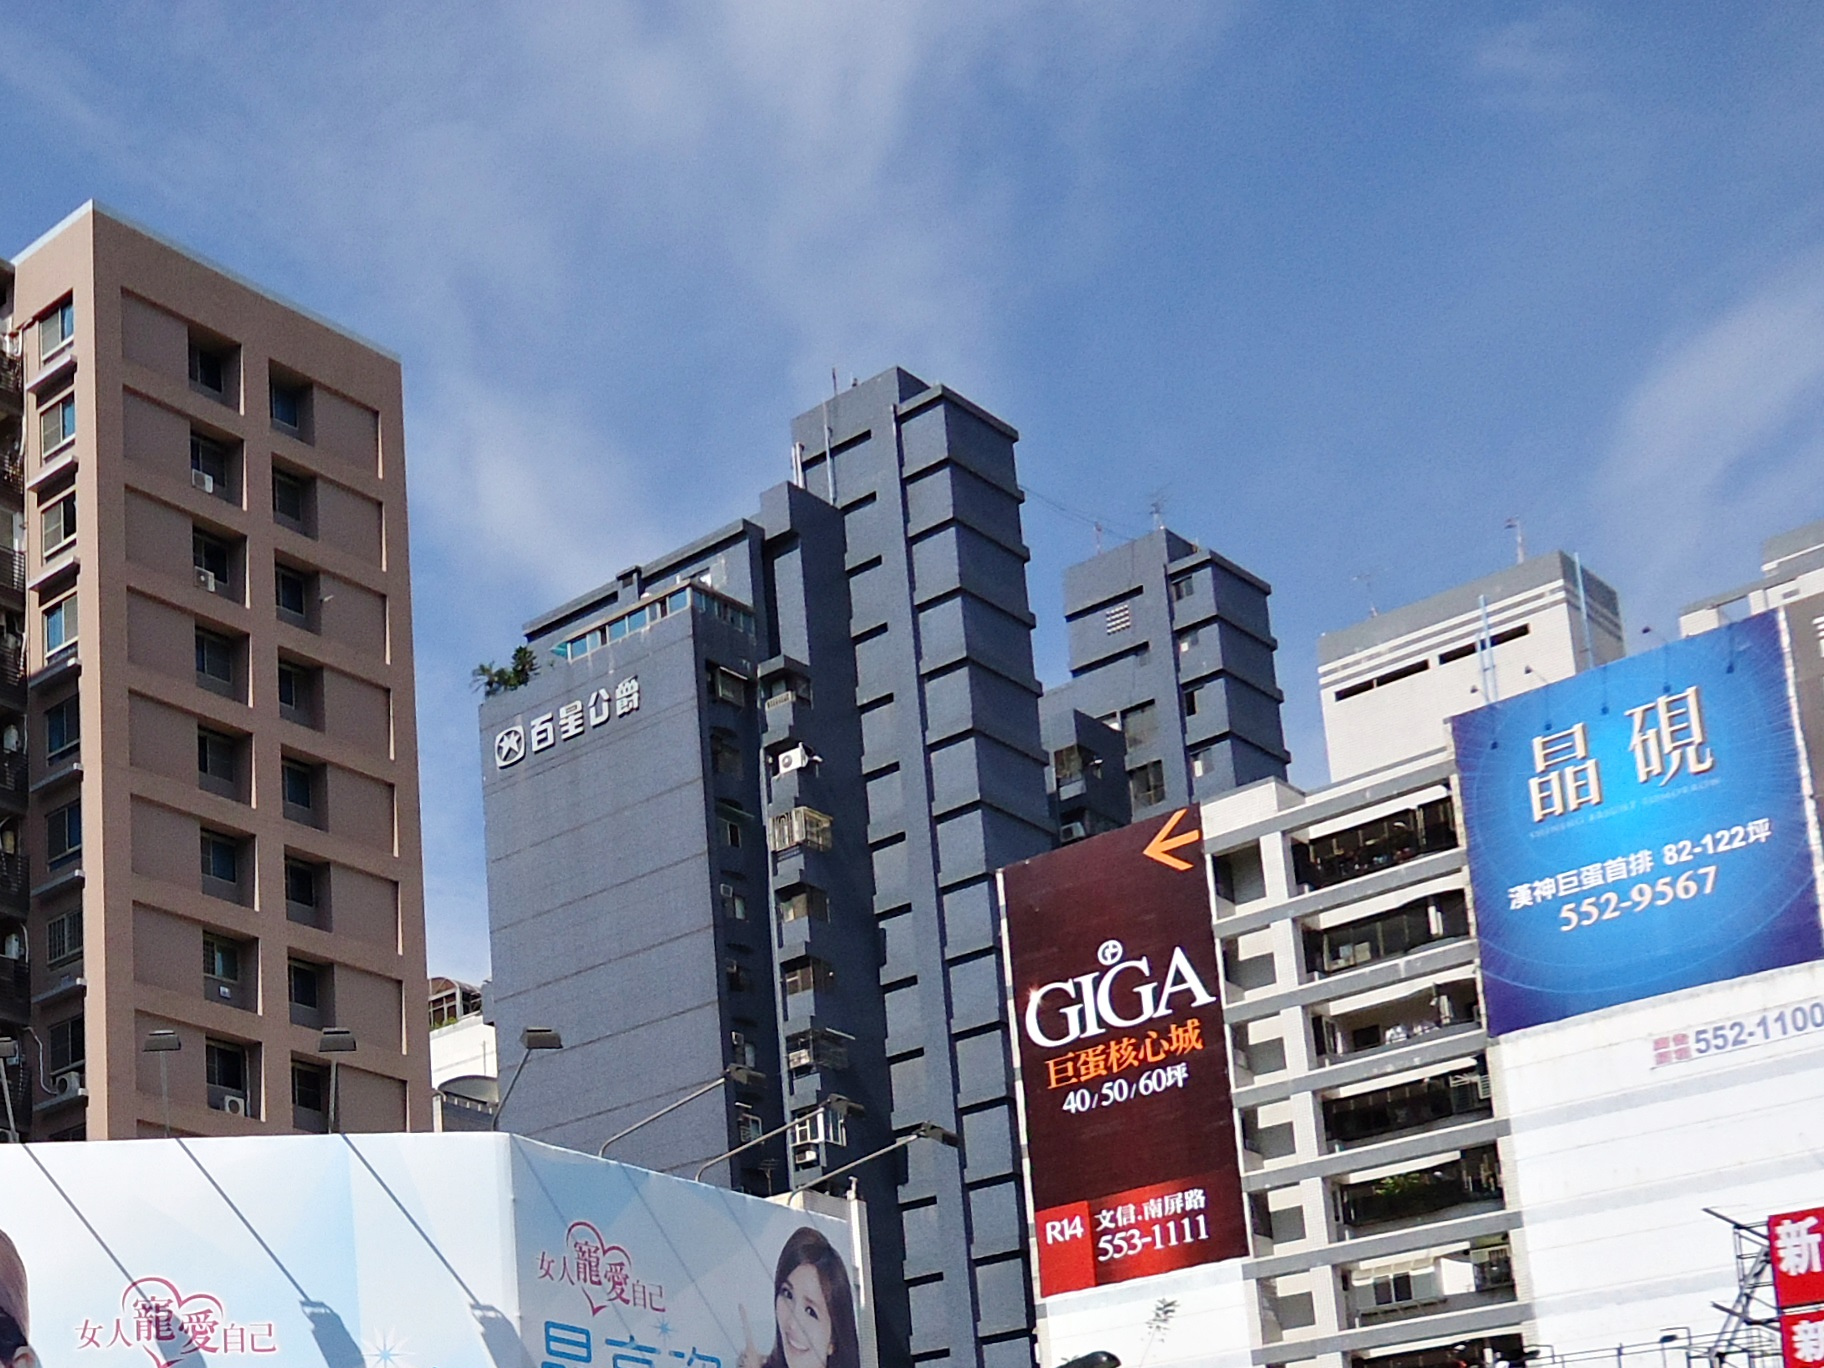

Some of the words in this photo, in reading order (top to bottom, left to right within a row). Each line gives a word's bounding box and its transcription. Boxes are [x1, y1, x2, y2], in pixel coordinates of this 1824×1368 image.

[1528, 686, 1714, 823] 晶硯
[1507, 850, 1653, 911] 漢神巨蛋首排
[1662, 817, 1773, 867] 82-122坪
[1559, 865, 1719, 932] 552-9567
[1024, 945, 1217, 1050] GIGA
[1694, 1001, 1824, 1054] 552-1100
[1045, 1018, 1204, 1090] 巨蛋核心城
[1045, 1214, 1085, 1245] R14
[1096, 1214, 1210, 1264] 553-1111
[1774, 1215, 1822, 1277] 新
[536, 1241, 666, 1312] 女人寵愛自己
[74, 1296, 277, 1356] 女人寵愛自己
